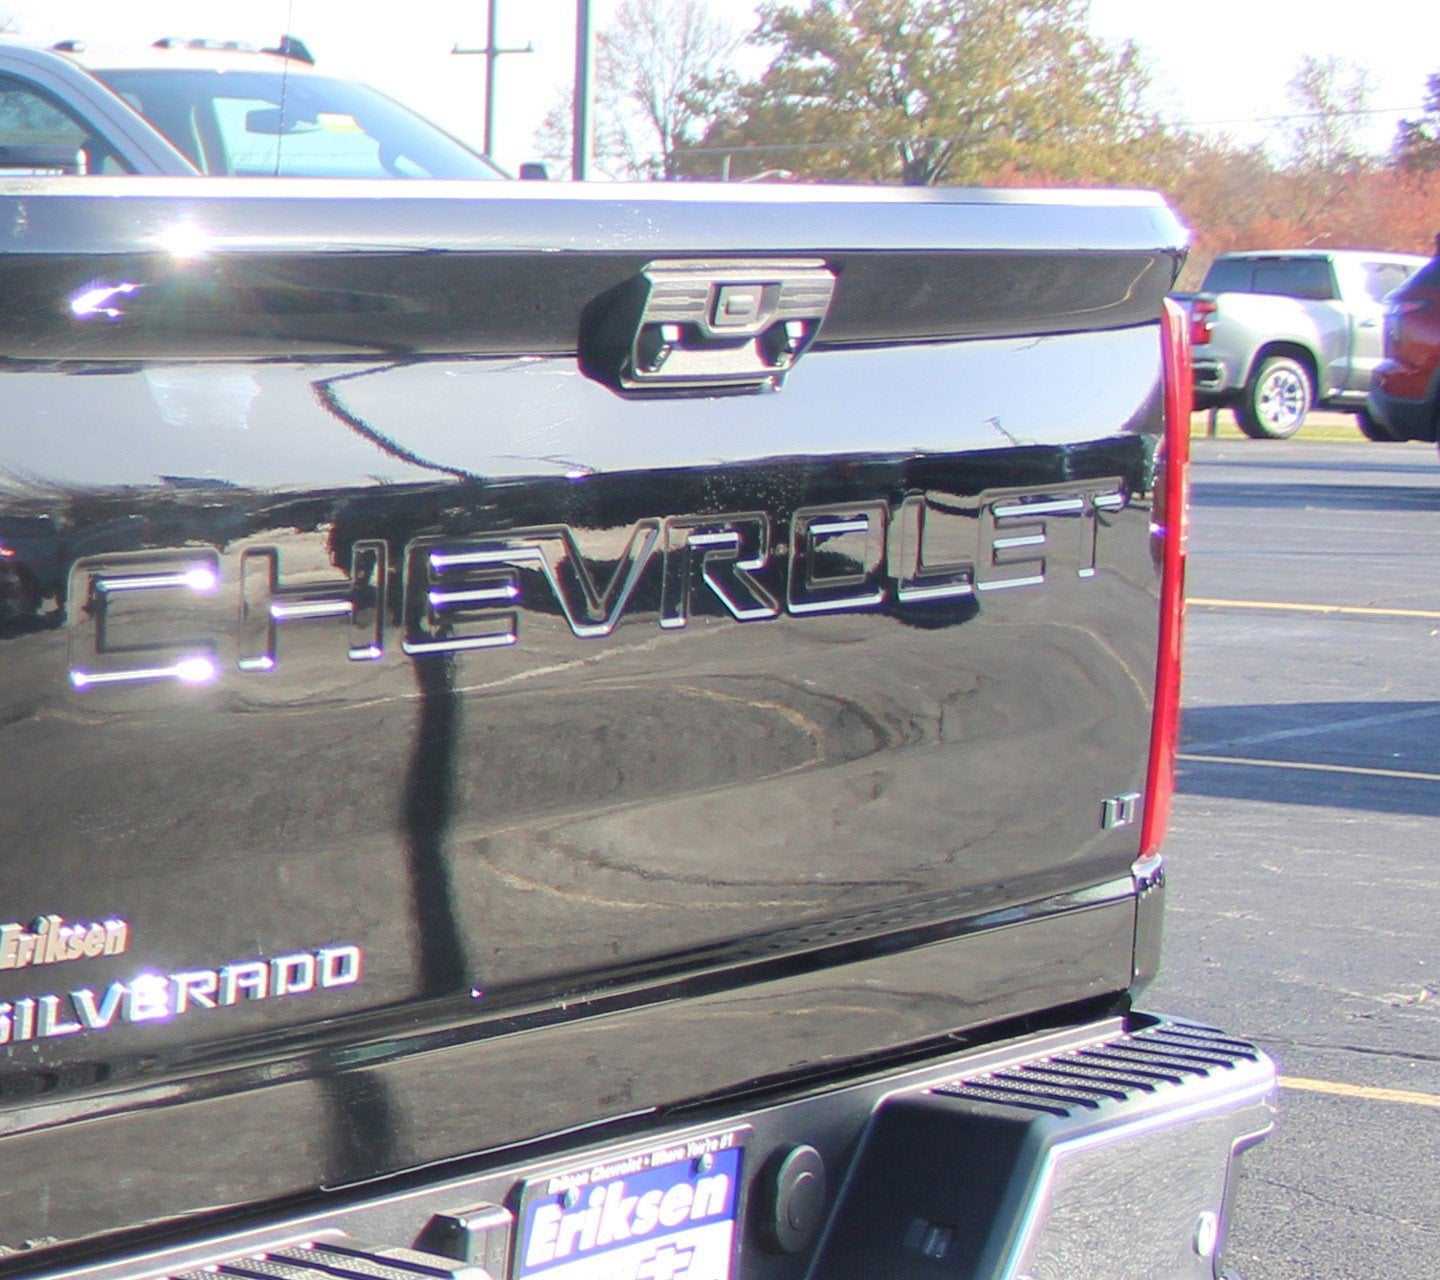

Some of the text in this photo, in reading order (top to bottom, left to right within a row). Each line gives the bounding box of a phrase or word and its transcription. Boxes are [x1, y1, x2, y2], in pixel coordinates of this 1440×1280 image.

[68, 476, 1127, 687] CHEVROLET
[1101, 792, 1140, 829] LT
[526, 1173, 729, 1267] Eriksen
